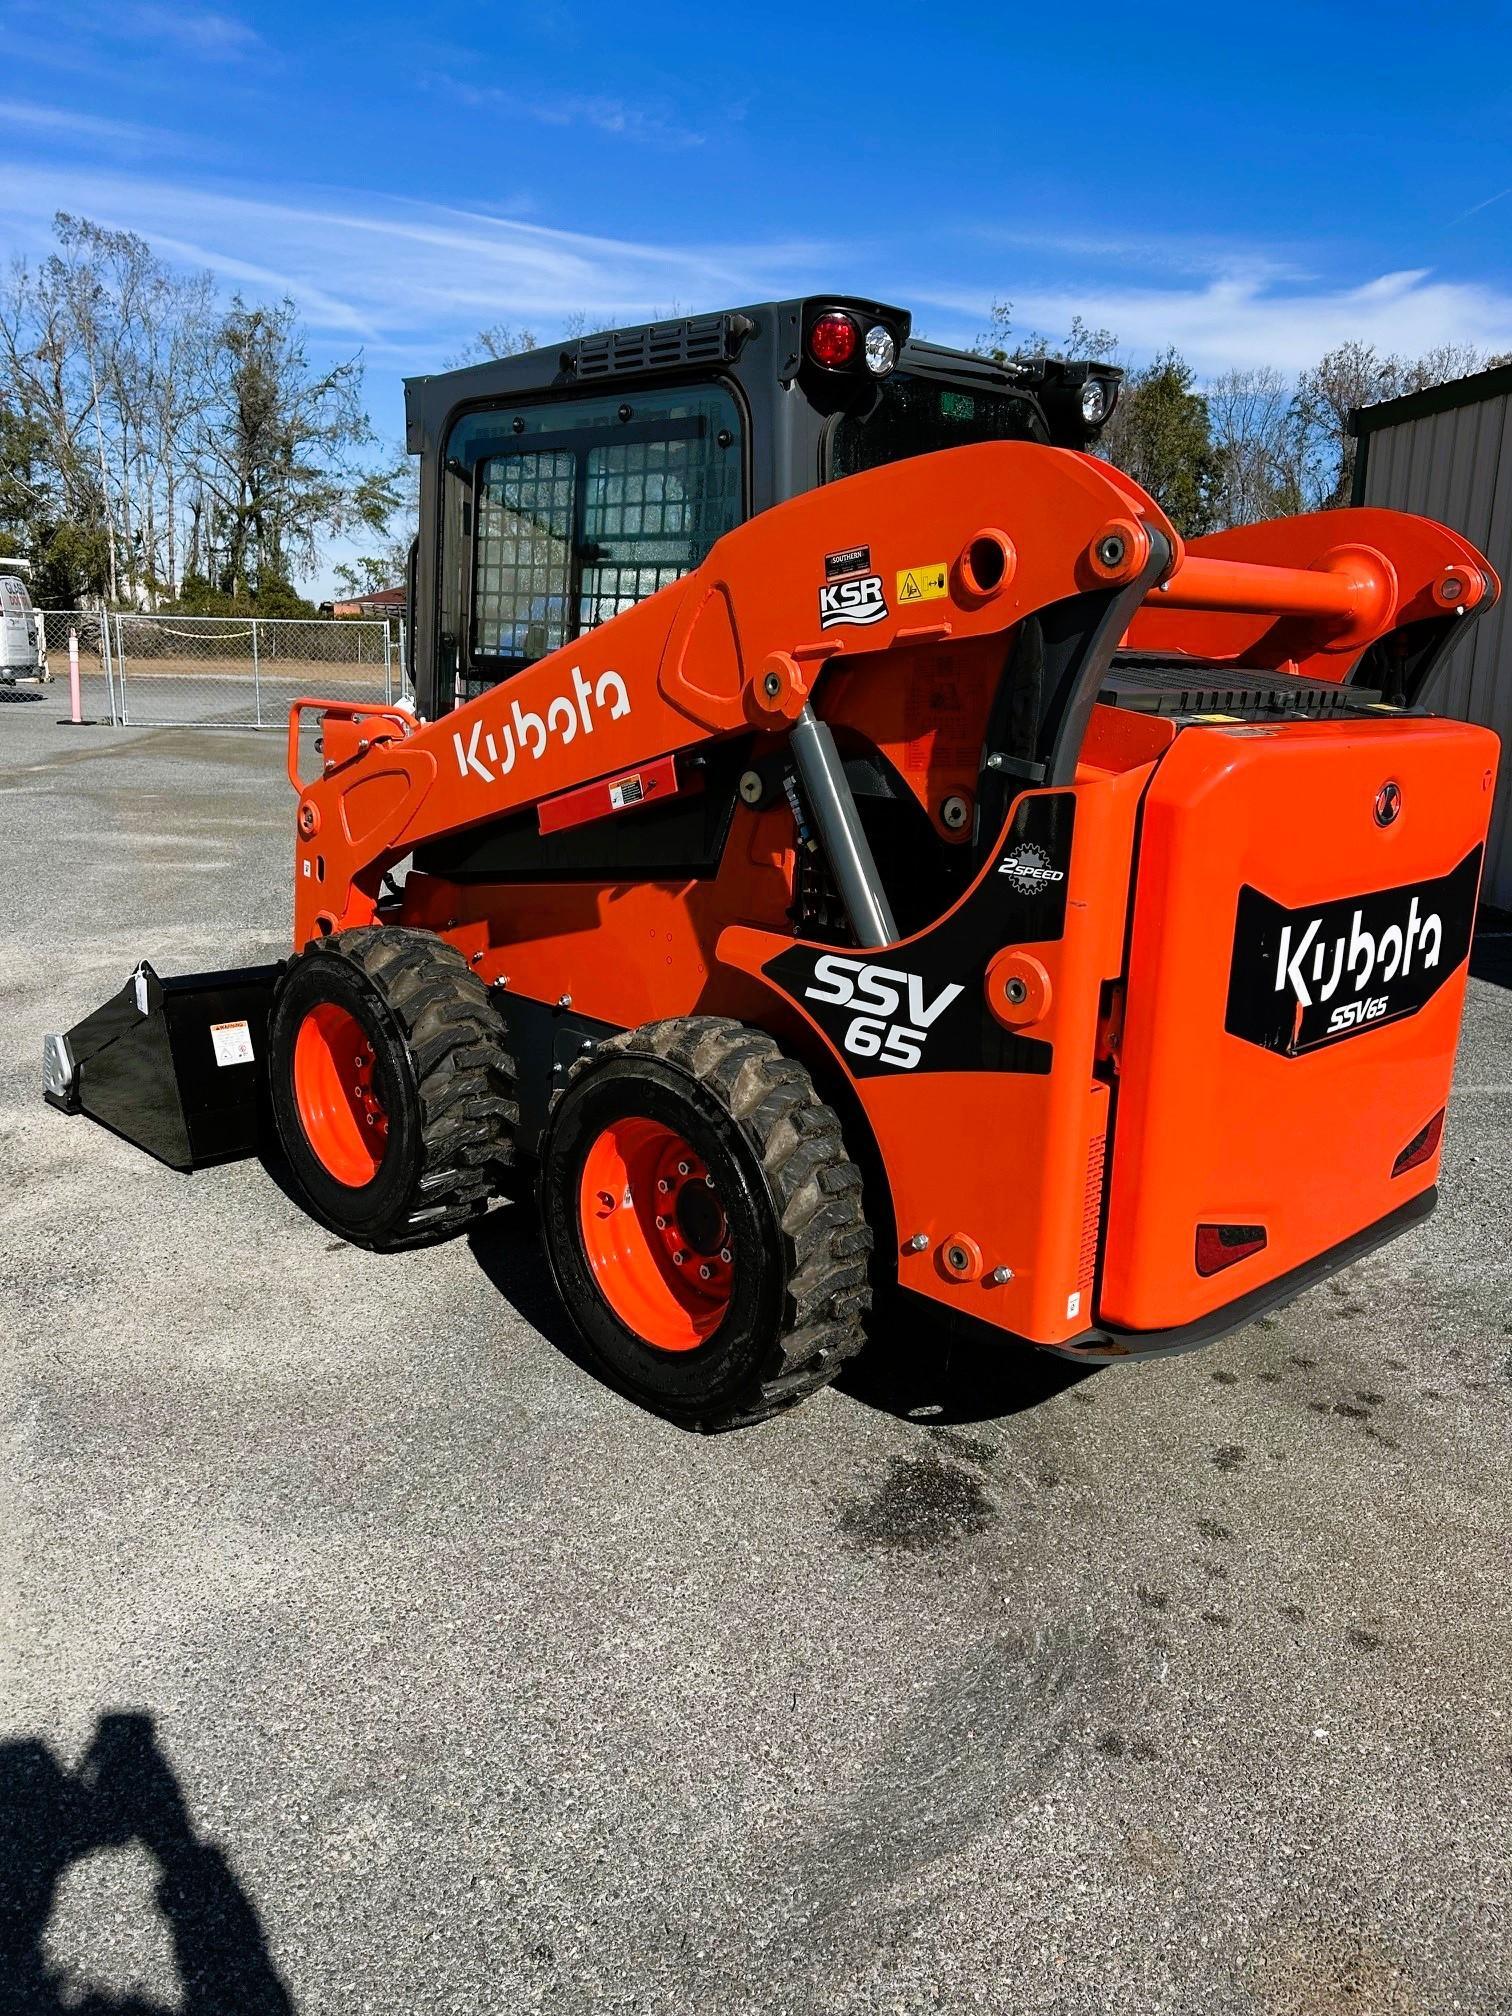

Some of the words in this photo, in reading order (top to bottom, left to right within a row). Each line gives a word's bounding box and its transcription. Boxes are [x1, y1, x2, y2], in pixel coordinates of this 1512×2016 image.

[832, 551, 862, 564] SOUTHERN
[820, 577, 882, 612] KSR
[453, 666, 632, 783] Kubota
[1274, 896, 1442, 1008] Kubota
[804, 954, 965, 1028] SSV
[1326, 995, 1389, 1034] SSV65
[844, 1016, 928, 1069] 65
